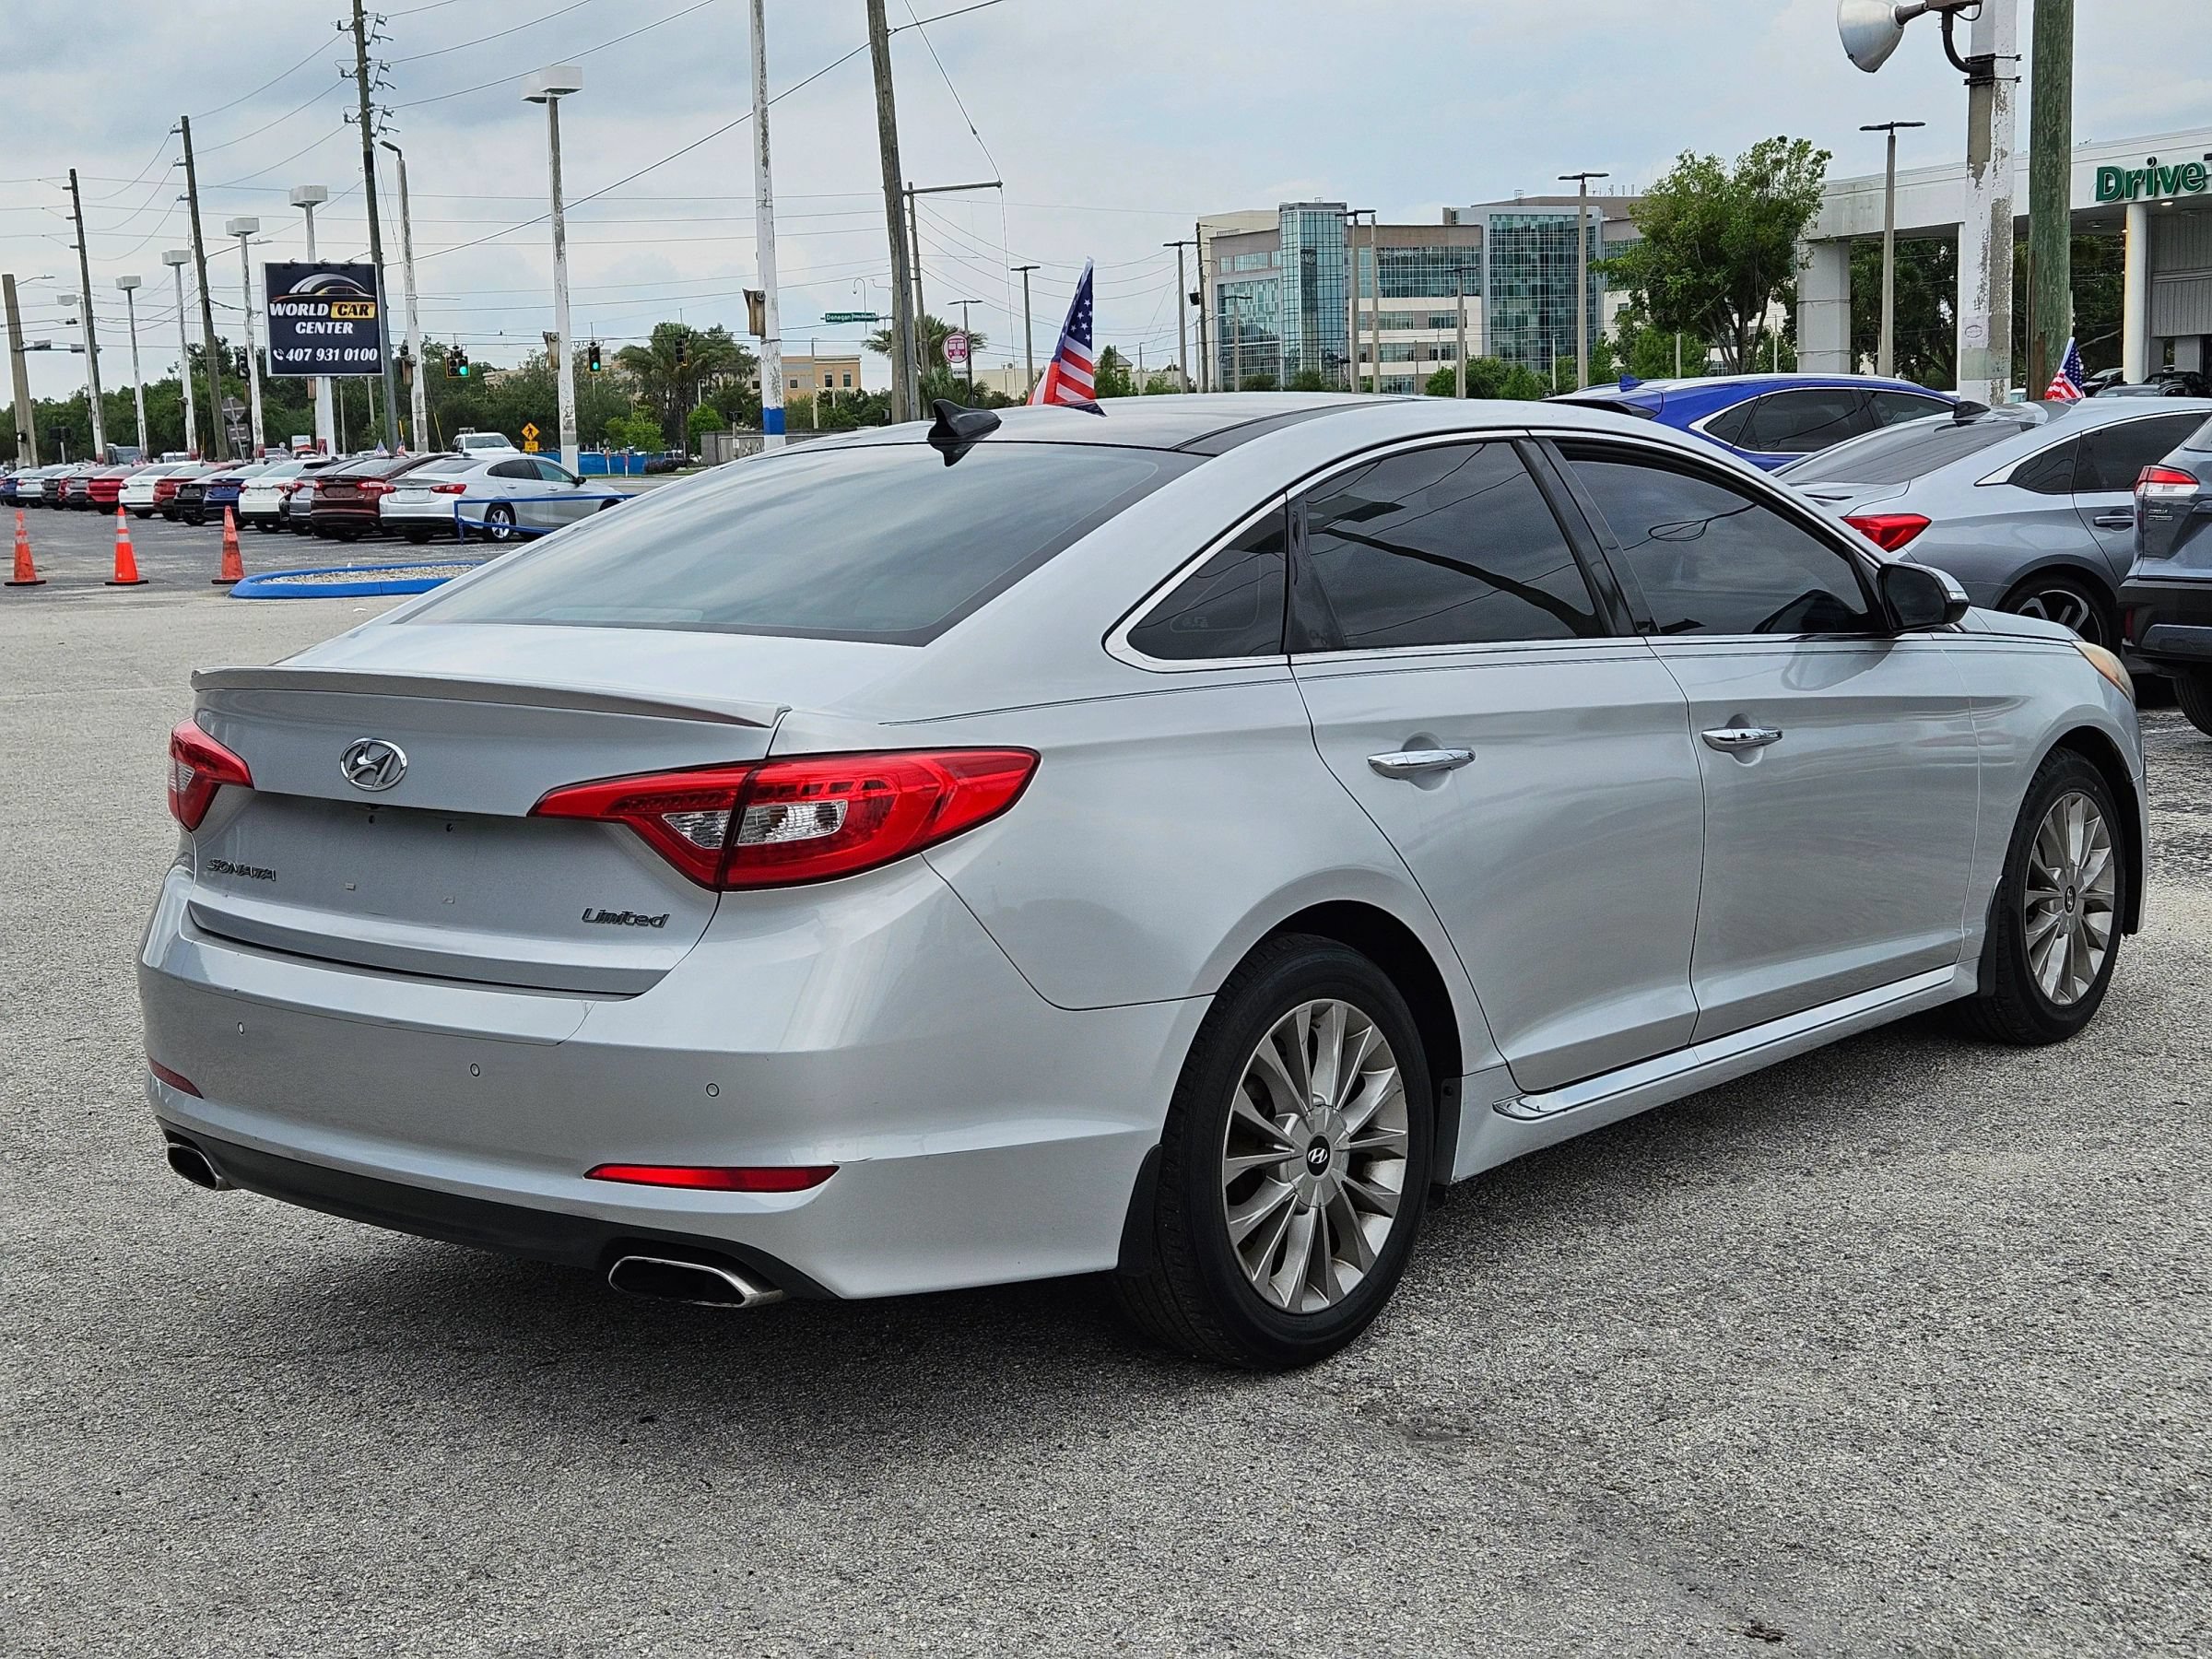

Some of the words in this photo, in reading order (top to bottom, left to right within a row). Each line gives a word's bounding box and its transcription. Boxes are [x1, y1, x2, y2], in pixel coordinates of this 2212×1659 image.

[269, 303, 329, 316] WORLD
[336, 303, 370, 316] CAR
[295, 321, 354, 335] CENTER
[286, 347, 312, 362] 407
[315, 347, 340, 361] 931
[344, 347, 378, 361] 0100
[206, 858, 276, 882] SONATA
[582, 907, 670, 928] Limited
